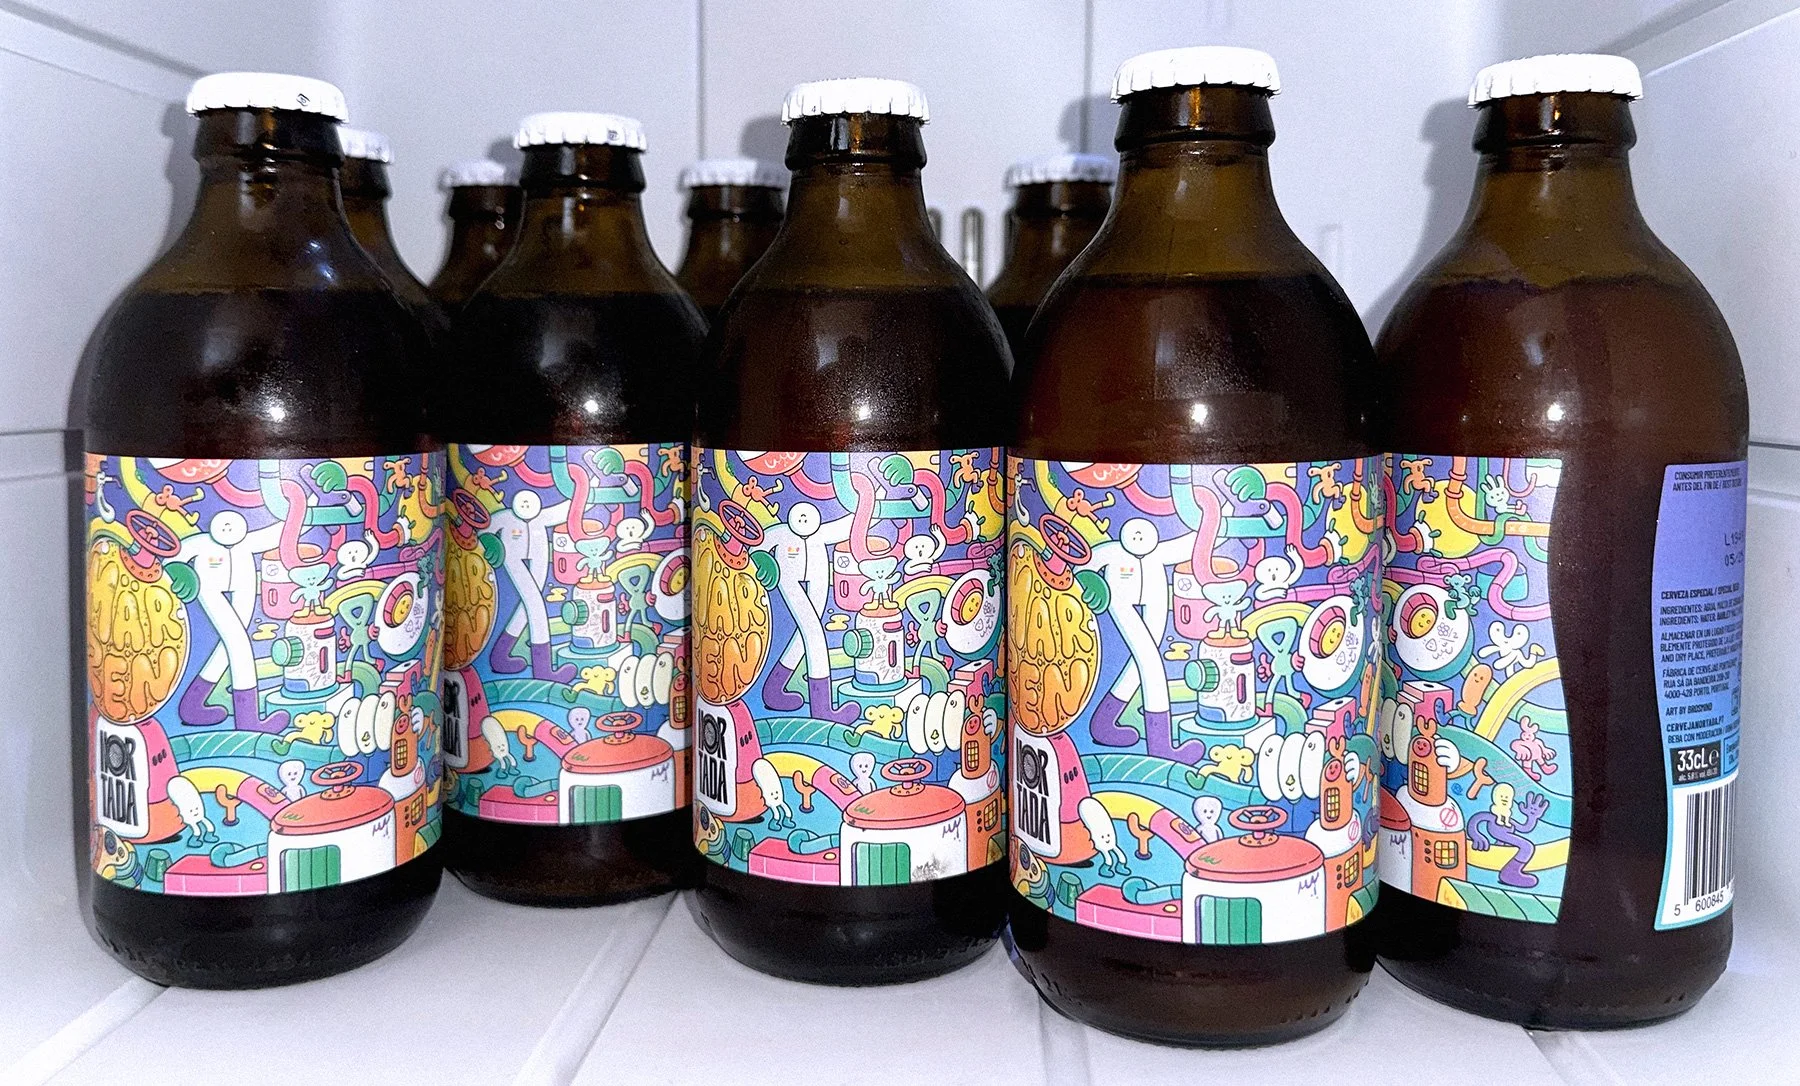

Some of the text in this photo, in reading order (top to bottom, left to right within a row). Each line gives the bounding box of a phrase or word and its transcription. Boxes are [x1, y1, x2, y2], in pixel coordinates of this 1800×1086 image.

[1674, 470, 1703, 481] CONSUMIR
[1673, 481, 1692, 491] ANTES
[1693, 480, 1703, 491] DEL
[1704, 481, 1712, 490] FIN
[1713, 480, 1719, 489] DE
[1661, 590, 1689, 600] CERVEZA
[1690, 588, 1713, 598] ESPECIAL
[1661, 630, 1696, 641] ALMACENAR
[1696, 629, 1703, 639] EN
[1660, 641, 1692, 652] BLEMENTE
[1661, 653, 1675, 663] AND
[1675, 652, 1687, 662] DRY
[1663, 666, 1687, 678] FÁBRICA
[1688, 666, 1695, 676] DE
[1664, 679, 1676, 689] RUA
[1685, 678, 1693, 687] DA
[1664, 688, 1693, 699] 4000-428
[1666, 706, 1678, 716] ART
[1679, 705, 1687, 715] BY
[1668, 734, 1683, 744] BEBA
[1684, 733, 1695, 743] CON
[698, 751, 728, 805] TADA
[101, 772, 138, 826] TADA
[1017, 783, 1051, 846] TADA
[1674, 890, 1724, 916] 5 600845
